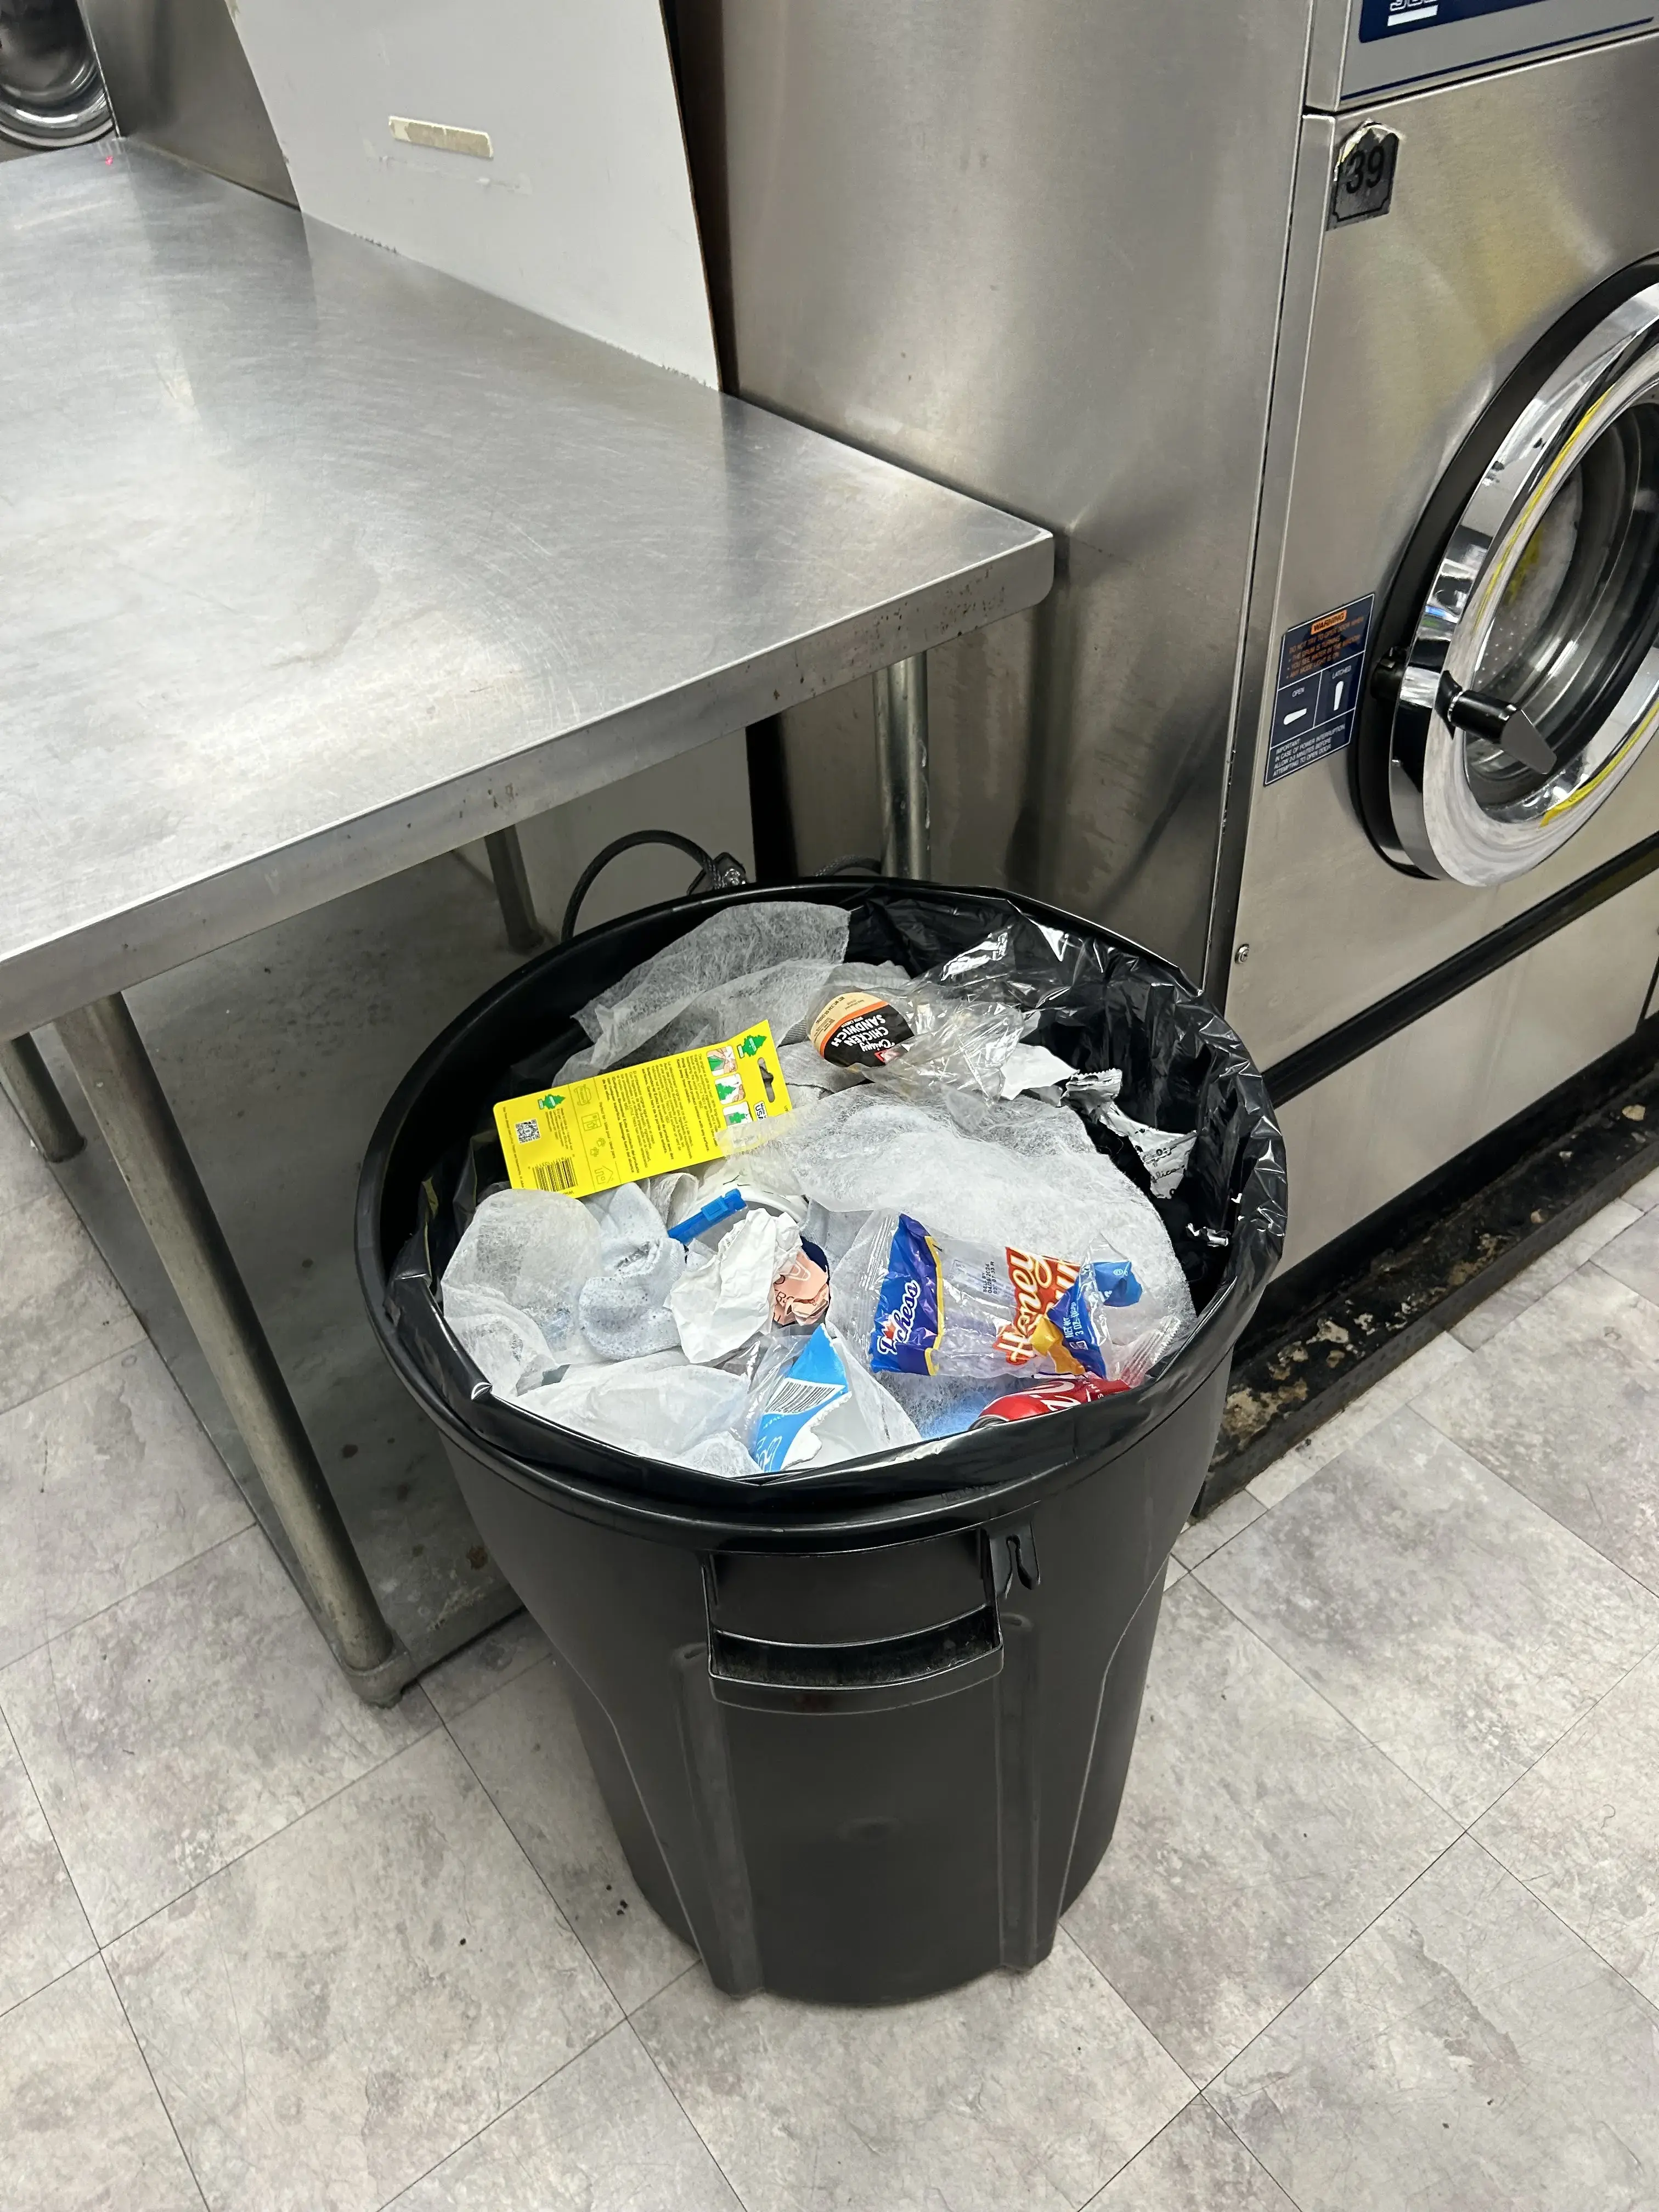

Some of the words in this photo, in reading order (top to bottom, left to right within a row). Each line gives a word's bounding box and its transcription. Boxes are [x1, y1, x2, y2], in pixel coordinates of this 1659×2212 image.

[1345, 145, 1386, 195] 39
[1314, 613, 1344, 631] WARNING
[1333, 665, 1351, 679] LATCHED
[1292, 687, 1305, 697] OPEN
[831, 1014, 885, 1047] SANDWICH
[844, 1027, 889, 1046] CHICKEN
[859, 1039, 895, 1052] Crispy
[996, 1249, 1052, 1363] Honey
[1064, 1327, 1074, 1338] NET
